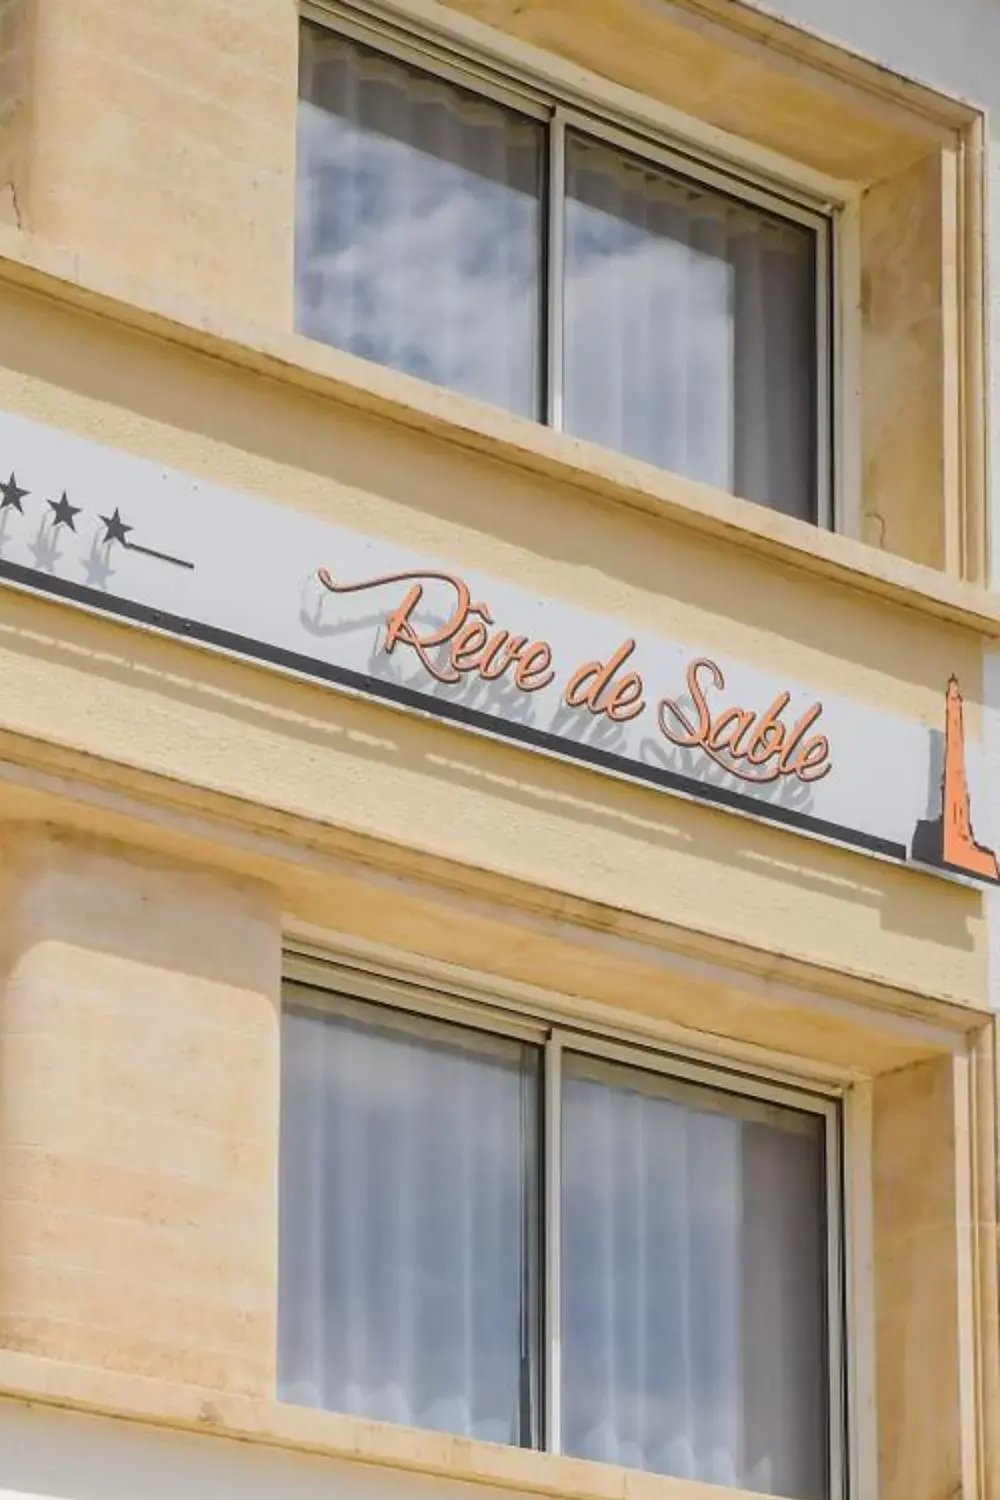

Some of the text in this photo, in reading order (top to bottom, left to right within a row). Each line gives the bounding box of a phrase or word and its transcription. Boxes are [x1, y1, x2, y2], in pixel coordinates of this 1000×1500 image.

[318, 569, 832, 783] Rêve de Sable
